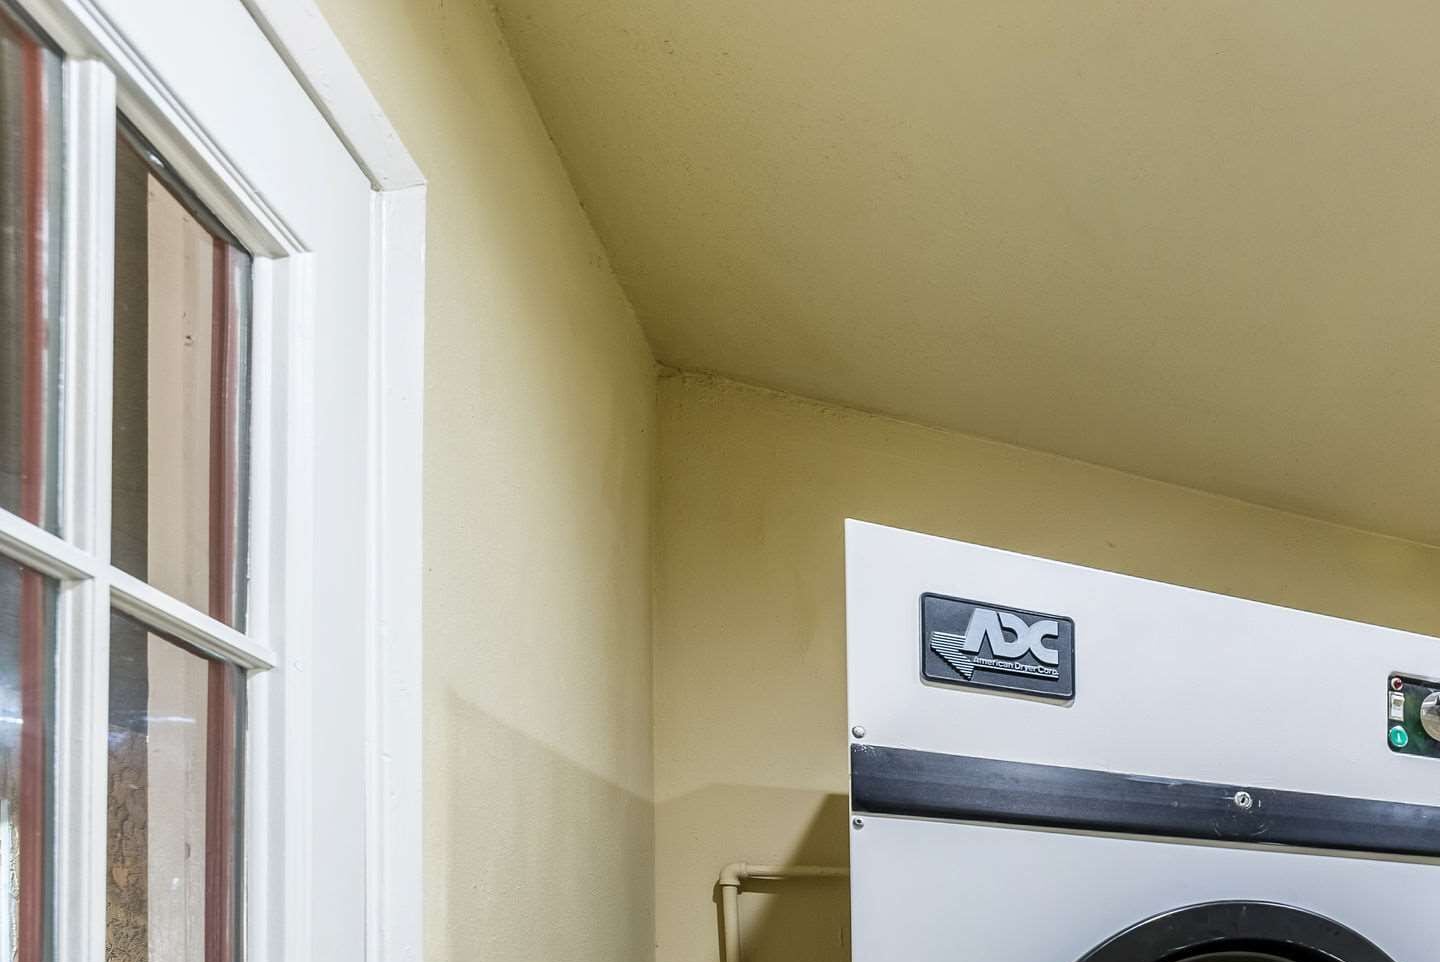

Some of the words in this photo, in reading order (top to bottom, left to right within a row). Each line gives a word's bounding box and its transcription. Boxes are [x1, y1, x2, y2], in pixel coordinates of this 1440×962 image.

[962, 608, 1059, 665] ADC
[974, 656, 1014, 670] American
[1014, 661, 1037, 674] Dryer
